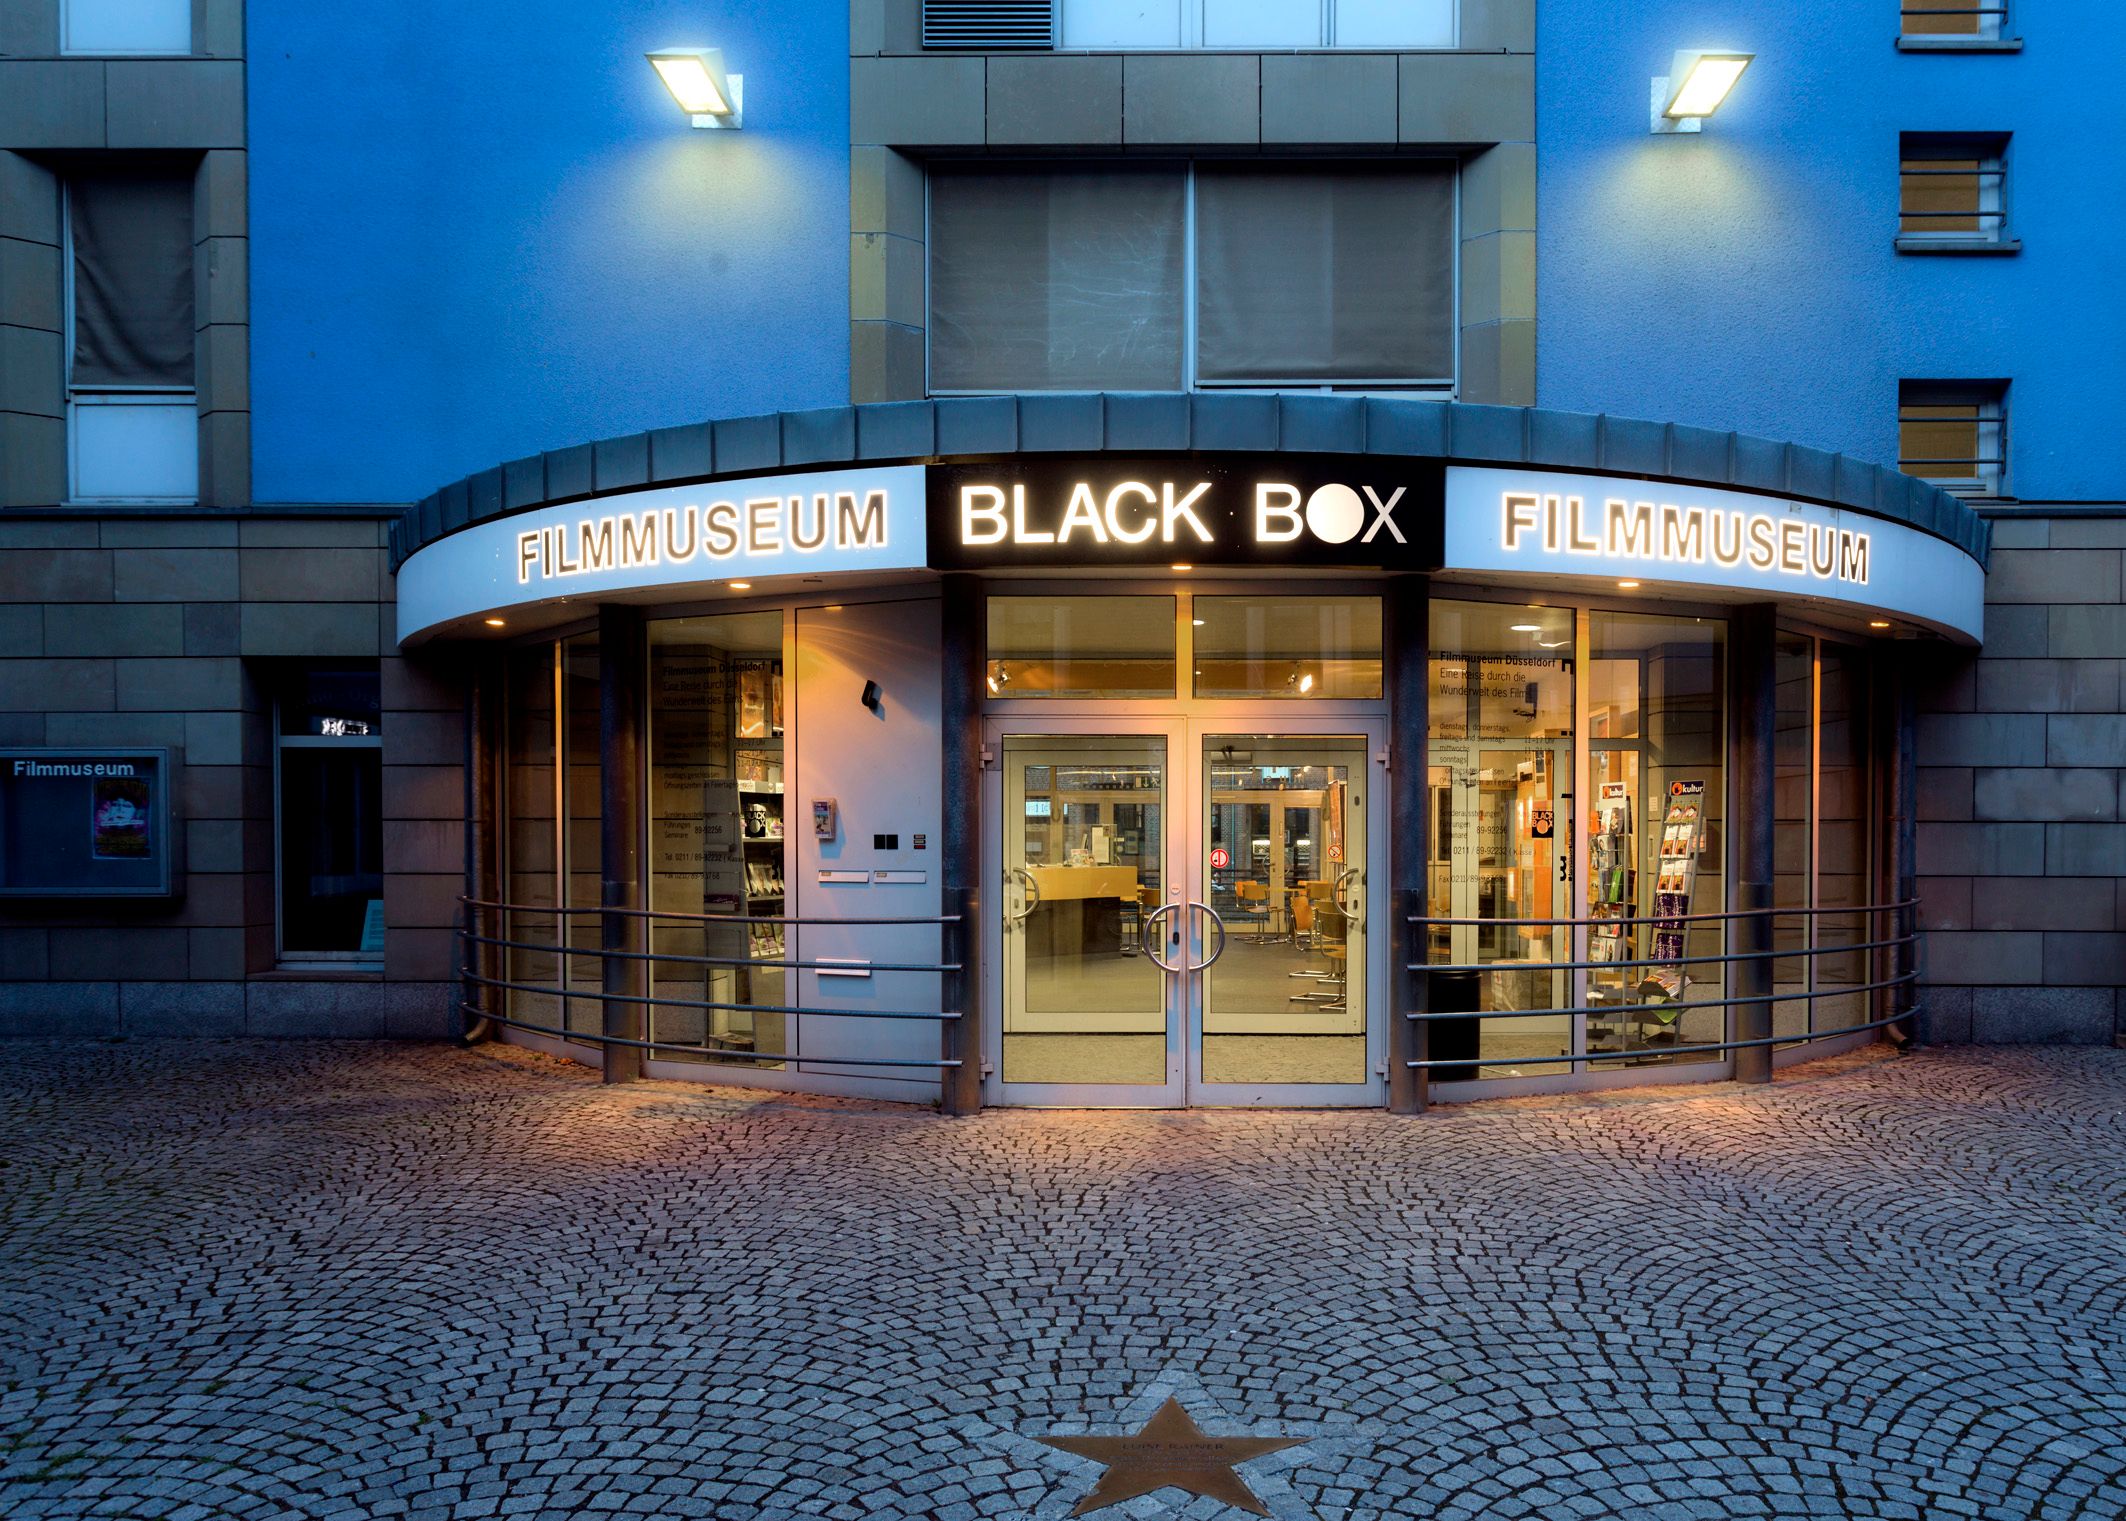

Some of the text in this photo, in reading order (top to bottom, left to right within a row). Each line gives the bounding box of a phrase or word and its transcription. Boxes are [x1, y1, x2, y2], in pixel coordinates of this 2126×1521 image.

[960, 480, 1408, 545] BLACK BOX
[517, 488, 888, 584] FILMMUSEUM
[1501, 491, 1871, 585] FILMMUSEUM
[1440, 651, 1556, 668] Filmmuseum Düsseldorf
[663, 661, 766, 677] Filmmuseum Düsseldorf
[1440, 667, 1526, 683] Eine Reise durch die
[703, 678, 725, 690] durch
[1440, 684, 1489, 697] Wunderwelt
[1492, 687, 1508, 698] des
[706, 695, 722, 705] des
[1440, 755, 1467, 764] sonntags
[13, 760, 135, 777] Filmmuseum
[745, 811, 766, 820] LACK
[1532, 811, 1553, 820] BLACK
[1453, 846, 1469, 855] 0211
